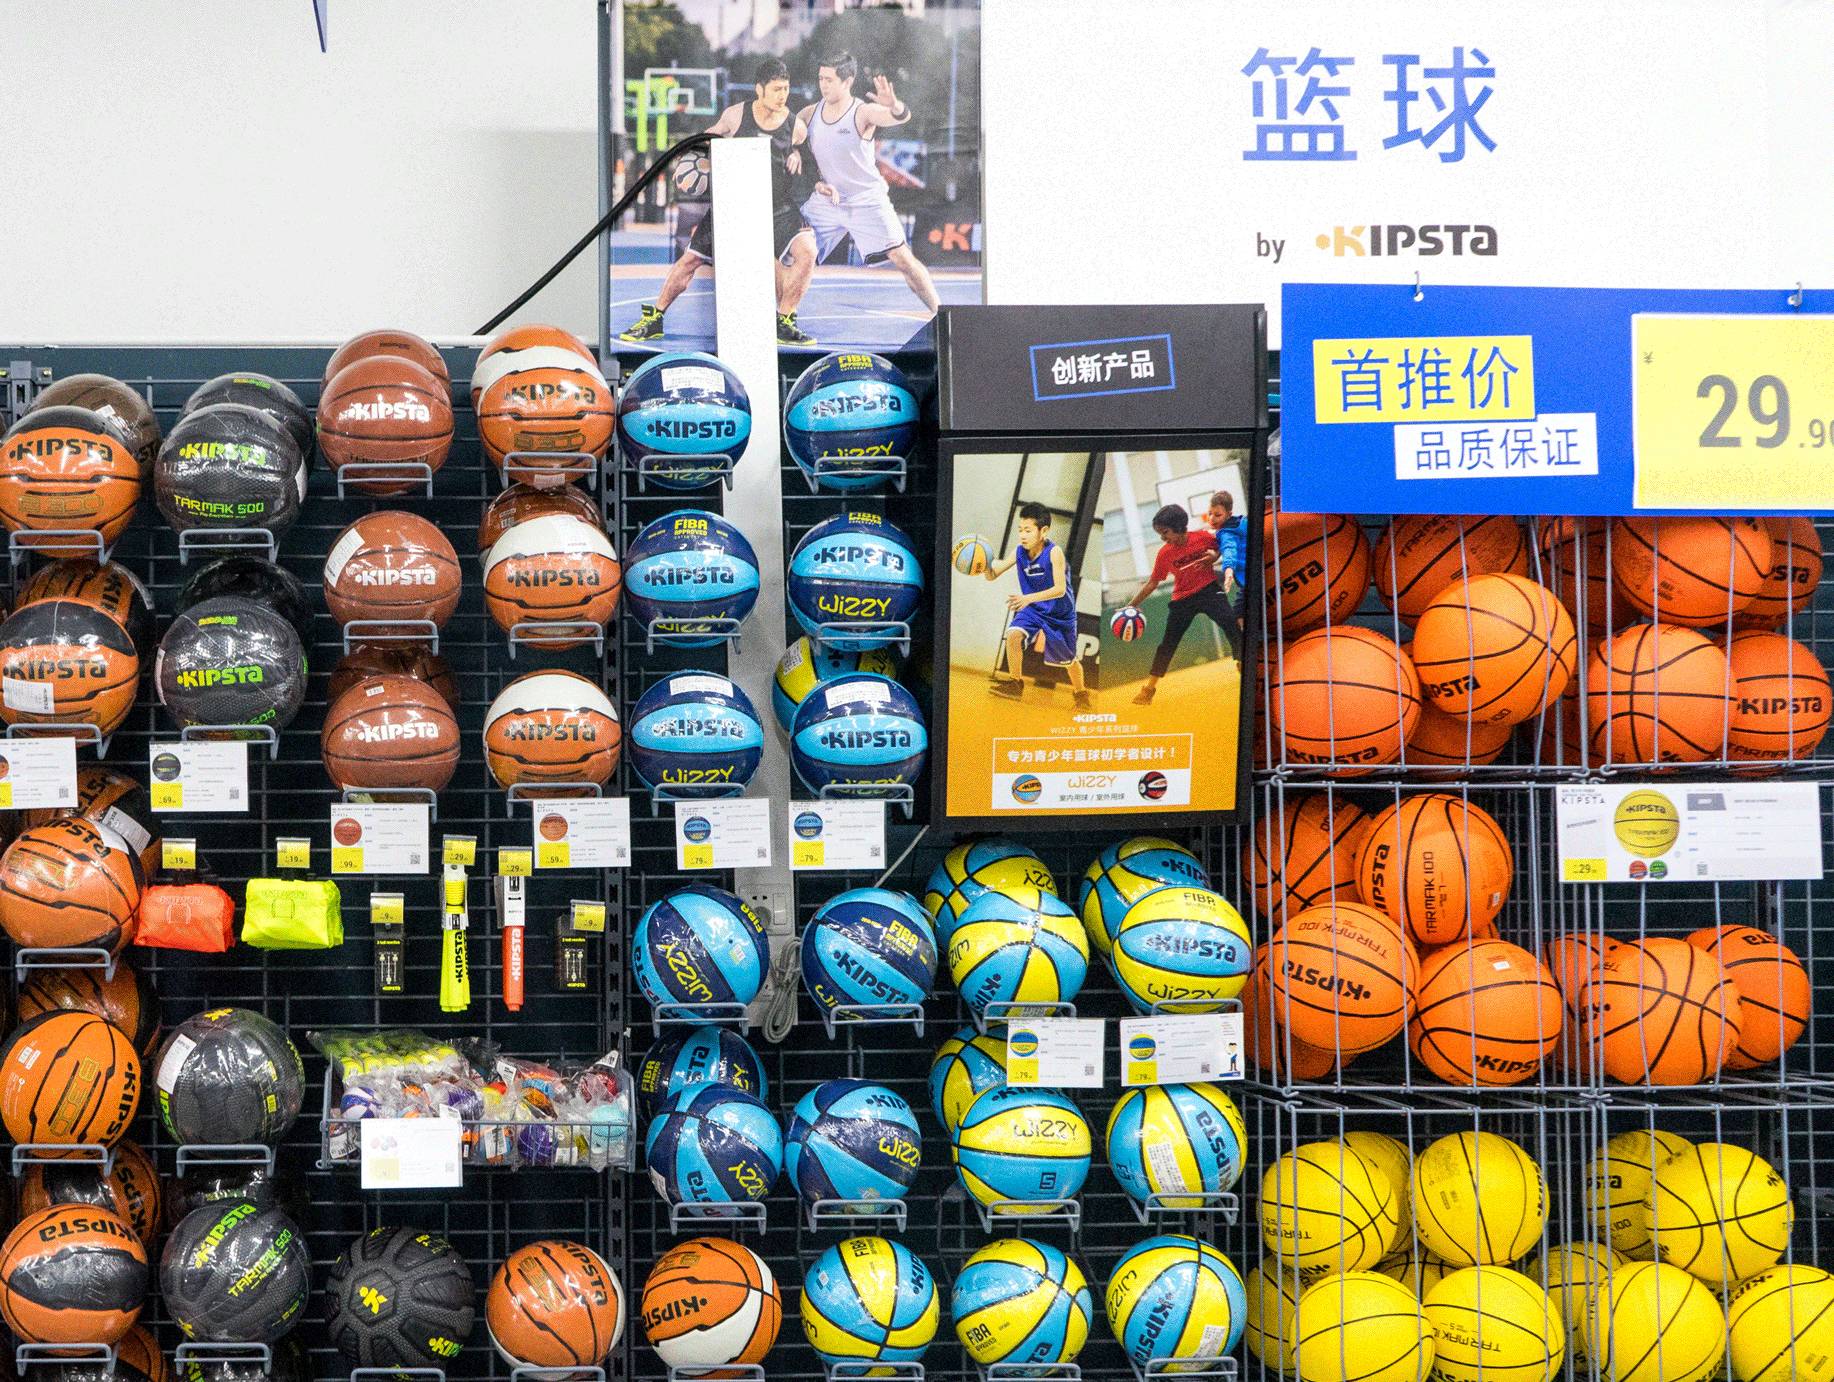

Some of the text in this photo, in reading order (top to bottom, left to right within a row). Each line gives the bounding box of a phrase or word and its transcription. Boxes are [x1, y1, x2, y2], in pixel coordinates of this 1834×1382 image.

[1241, 46, 1499, 163] 篮球
[1256, 232, 1286, 264] by
[1051, 349, 1155, 386] 创新产品
[1331, 345, 1519, 411] 首推价
[1416, 424, 1581, 471] 品质保证
[174, 494, 265, 514] TARMAK 500
[674, 519, 708, 530] FIBA
[1423, 851, 1438, 934] TARMAK 100
[1322, 922, 1388, 958] TARMAK
[641, 1061, 656, 1092] FIBA
[966, 1323, 992, 1346] FIBA
